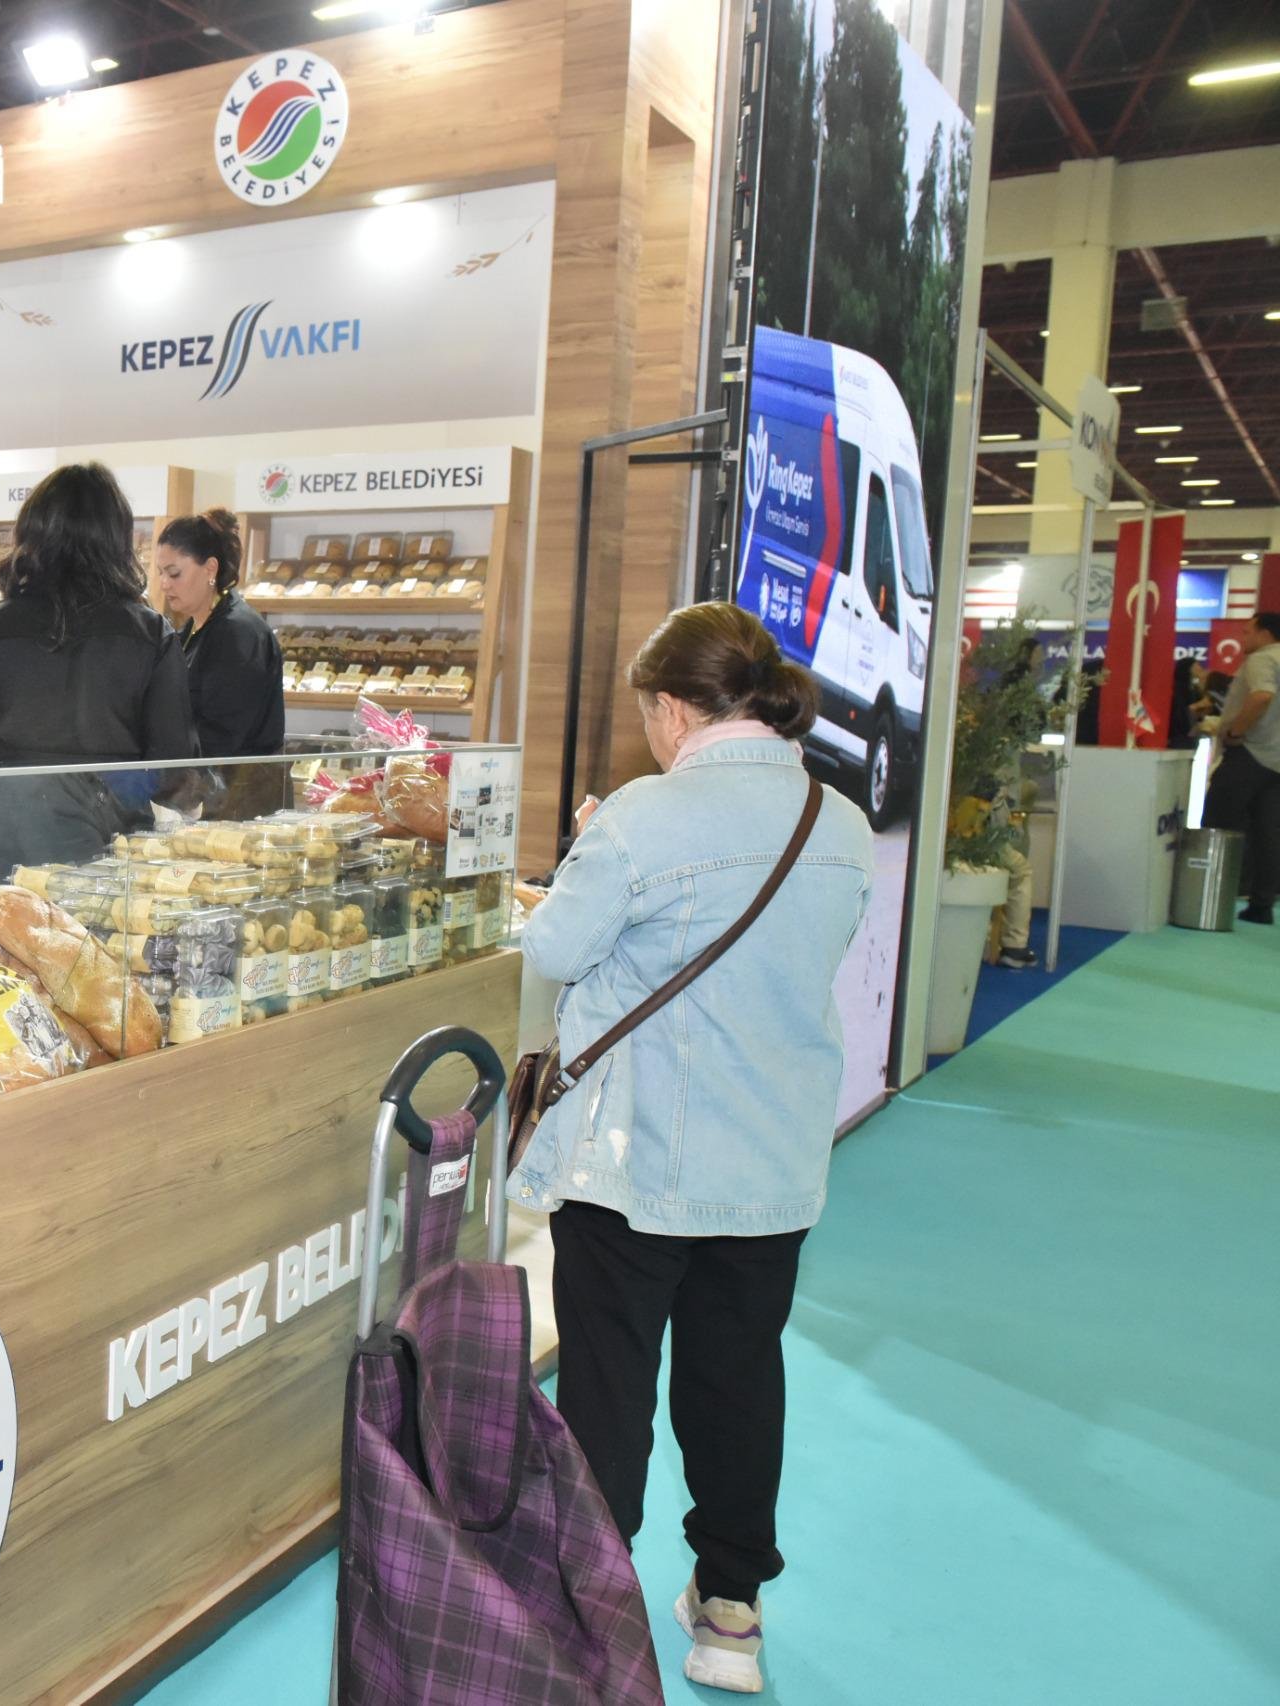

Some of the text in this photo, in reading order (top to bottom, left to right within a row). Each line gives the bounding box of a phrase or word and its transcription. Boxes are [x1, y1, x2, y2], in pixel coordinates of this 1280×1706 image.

[226, 58, 337, 117] KEPEZ
[220, 118, 340, 200] BELEDİYESİ
[122, 319, 360, 373] KEPEZ VAKFI
[299, 472, 358, 494] KEPEZ
[365, 465, 483, 491] BELEDİYESİ
[107, 1261, 269, 1422] KEPEZ
